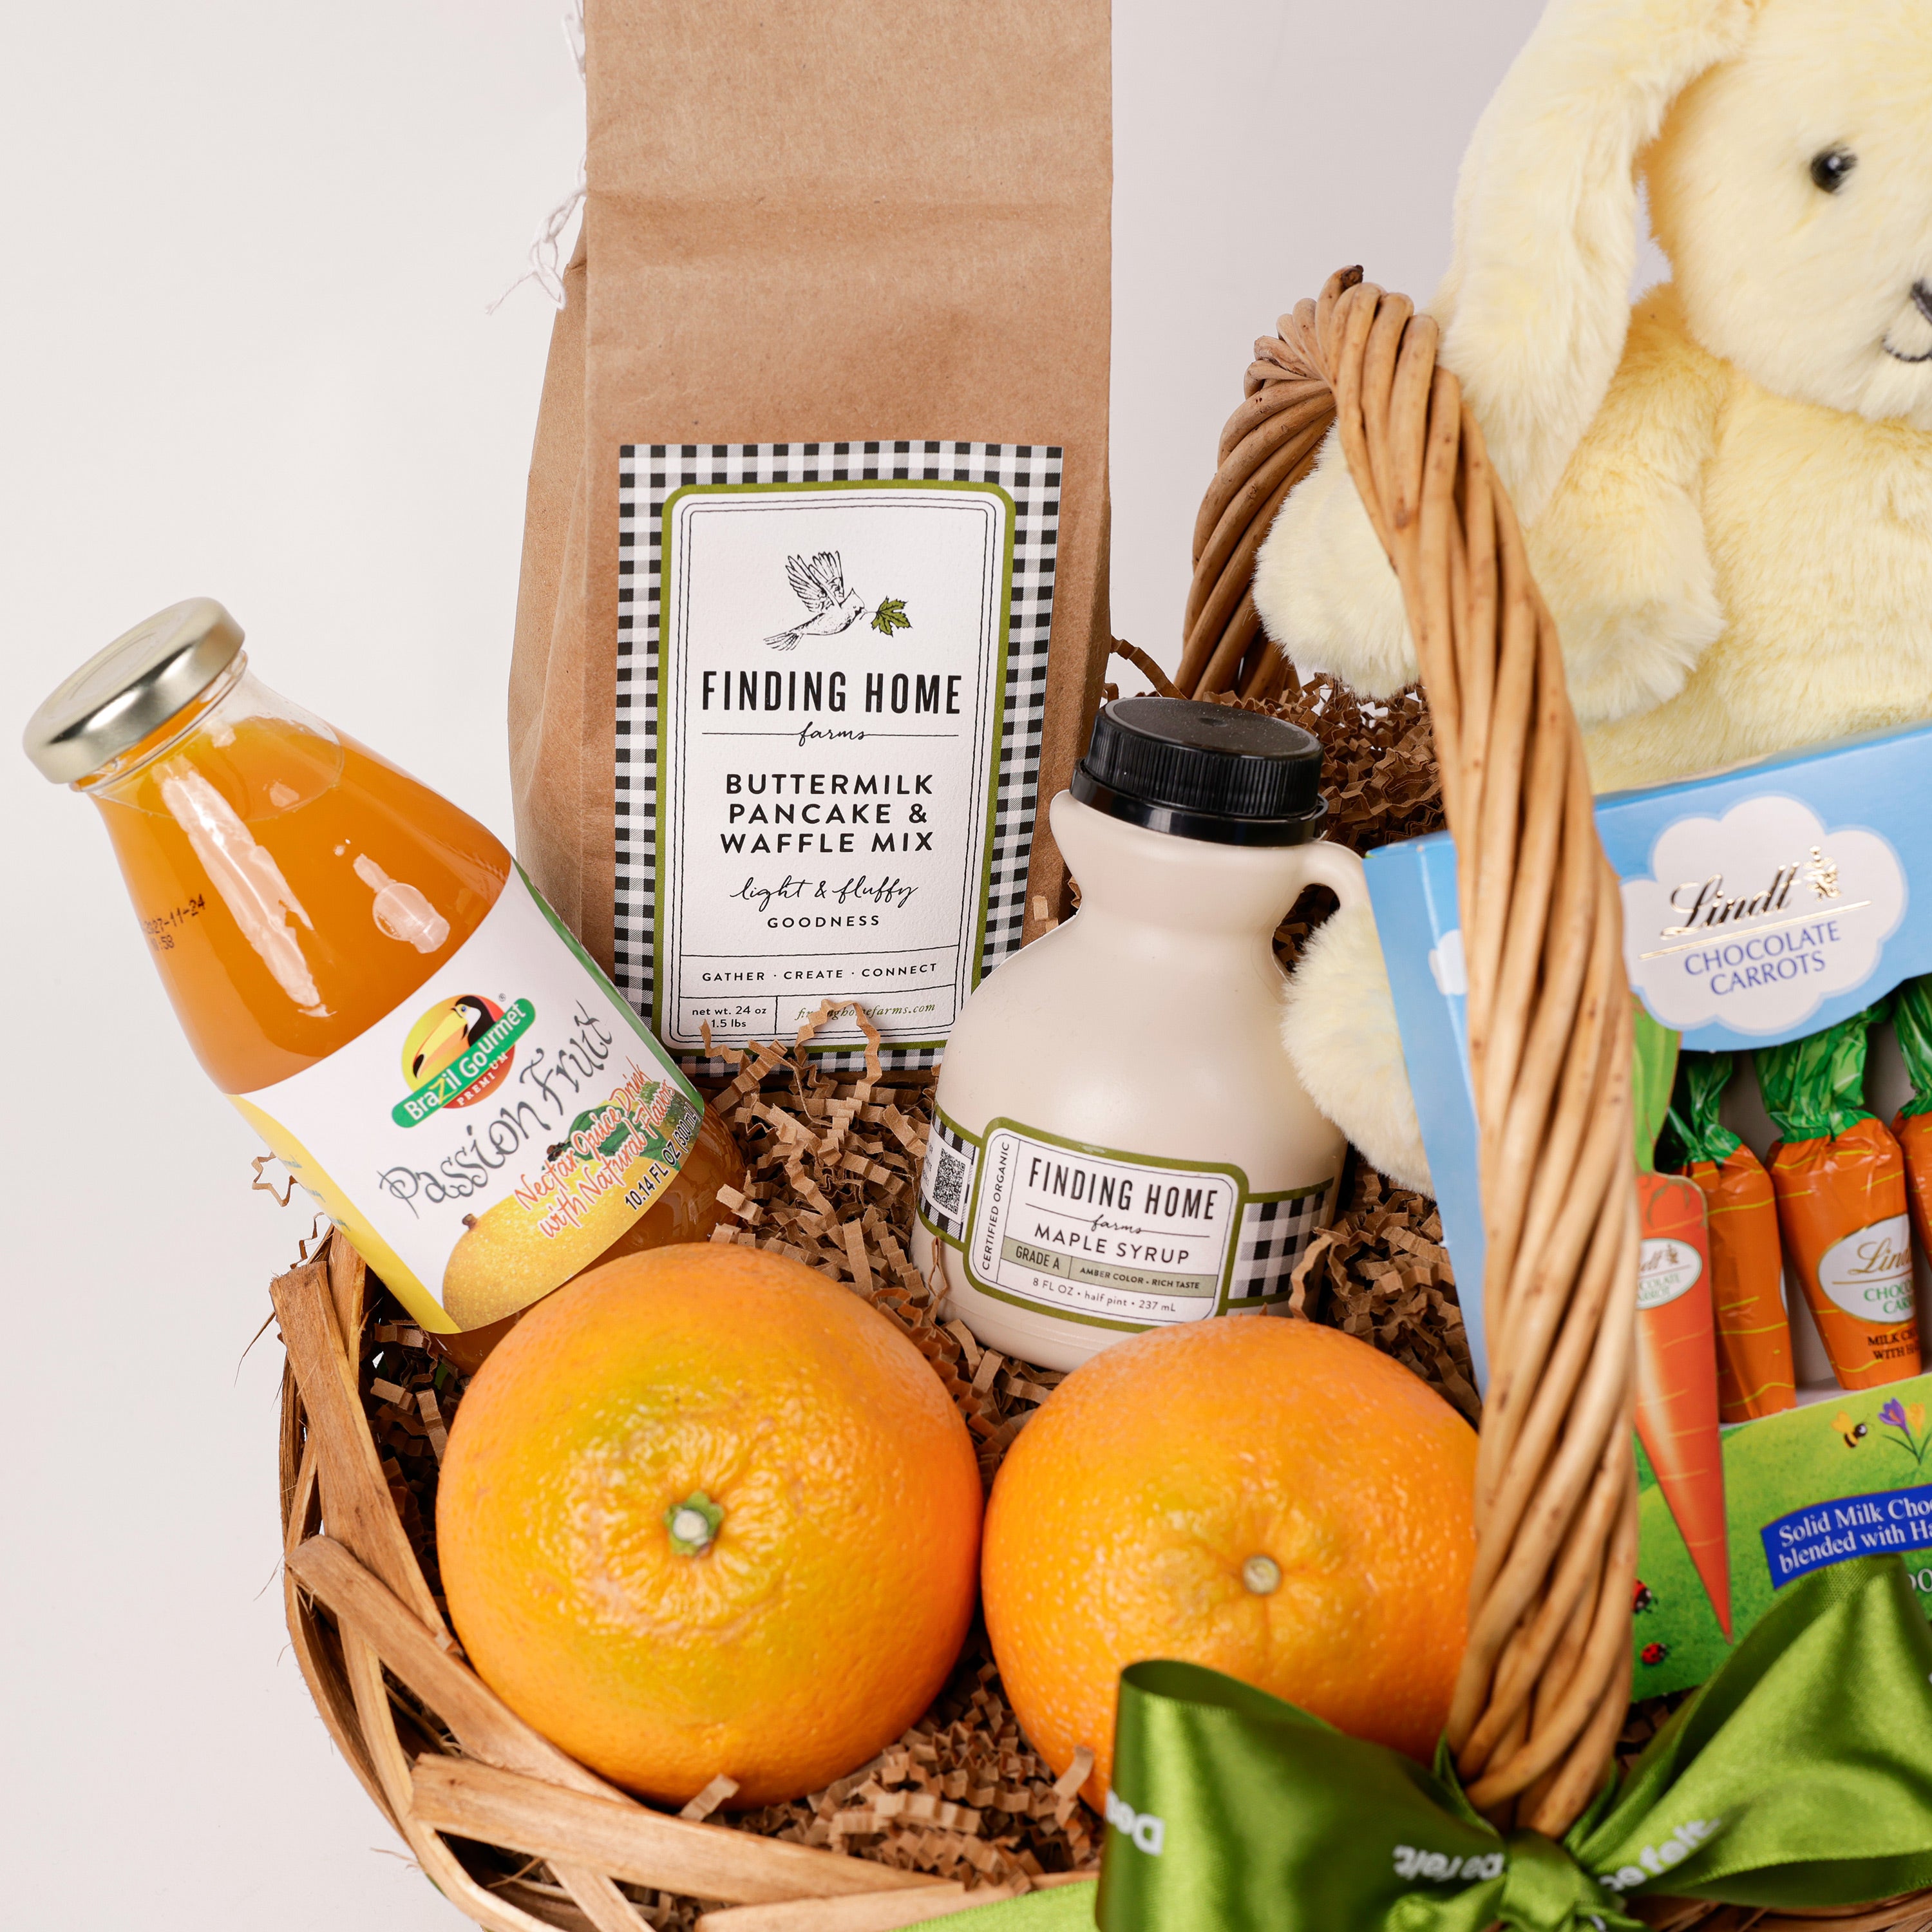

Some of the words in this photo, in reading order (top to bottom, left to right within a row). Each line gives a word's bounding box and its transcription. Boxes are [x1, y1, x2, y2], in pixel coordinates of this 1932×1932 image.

[702, 670, 847, 711] FINDING
[866, 673, 962, 714] HOME
[798, 721, 867, 746] farms
[726, 773, 933, 795] BUTTERMILK
[729, 803, 891, 824] PANCAKE
[909, 804, 927, 824] &
[720, 833, 855, 854] WAFFLE
[871, 831, 933, 853] MIX
[730, 875, 813, 913] light
[814, 880, 827, 898] &
[832, 876, 919, 908] fluffy
[1660, 861, 1802, 940] Lindt
[767, 915, 880, 929] GOODNESS
[1685, 921, 1841, 976] CHOCOLATE
[702, 971, 765, 983] GATHER
[783, 969, 844, 980] CREATE
[861, 962, 938, 978] CONNECT
[1710, 951, 1826, 996] CARROTS
[692, 1007, 710, 1016] net
[714, 1007, 732, 1016] wt.
[735, 1005, 751, 1015] 24
[711, 1019, 727, 1028] 1.5
[731, 1018, 747, 1028] lbs
[459, 1003, 527, 1079] Gourmet
[456, 1052, 509, 1106] PREMIUM
[377, 1101, 552, 1220] Passion
[519, 999, 613, 1116] Fruit
[514, 1150, 578, 1211] Nectar
[573, 1107, 622, 1162] Juice
[608, 1055, 654, 1117] Drink
[539, 1188, 589, 1238] with
[578, 1118, 648, 1204] Natural
[634, 1079, 676, 1139] Flavors
[625, 1175, 656, 1211] 10.14
[649, 1162, 669, 1184] FL
[662, 1141, 681, 1166] OZ
[672, 1120, 691, 1153] (300
[982, 1207, 1001, 1271] CERTIFIED
[992, 1141, 1010, 1203] ORGANIC
[1028, 1157, 1133, 1211] FINDING
[1144, 1183, 1218, 1220] HOME
[1034, 1224, 1107, 1255] MAPLE
[1116, 1242, 1190, 1265] SYRUP
[1090, 1214, 1145, 1234] farms
[1016, 1245, 1050, 1268] GRADE
[1052, 1256, 1060, 1271] A
[1079, 1267, 1111, 1279] AMBER
[1113, 1273, 1144, 1285] COLOR
[1151, 1278, 1173, 1287] RICH
[1176, 1280, 1200, 1289] TASTE
[1032, 1277, 1039, 1287] 8
[1042, 1280, 1055, 1292] FL
[1057, 1283, 1074, 1296] OZ
[1084, 1290, 1104, 1303] half
[1106, 1296, 1128, 1307] pint
[1139, 1300, 1157, 1311] 237
[1160, 1303, 1177, 1312] mL
[1868, 1333, 1900, 1347] MILK
[1779, 1511, 1832, 1548] Solid
[1834, 1502, 1885, 1529] Milk
[1888, 1497, 1932, 1520] Cho
[1778, 1530, 1857, 1575] blended
[1860, 1523, 1907, 1548] with
